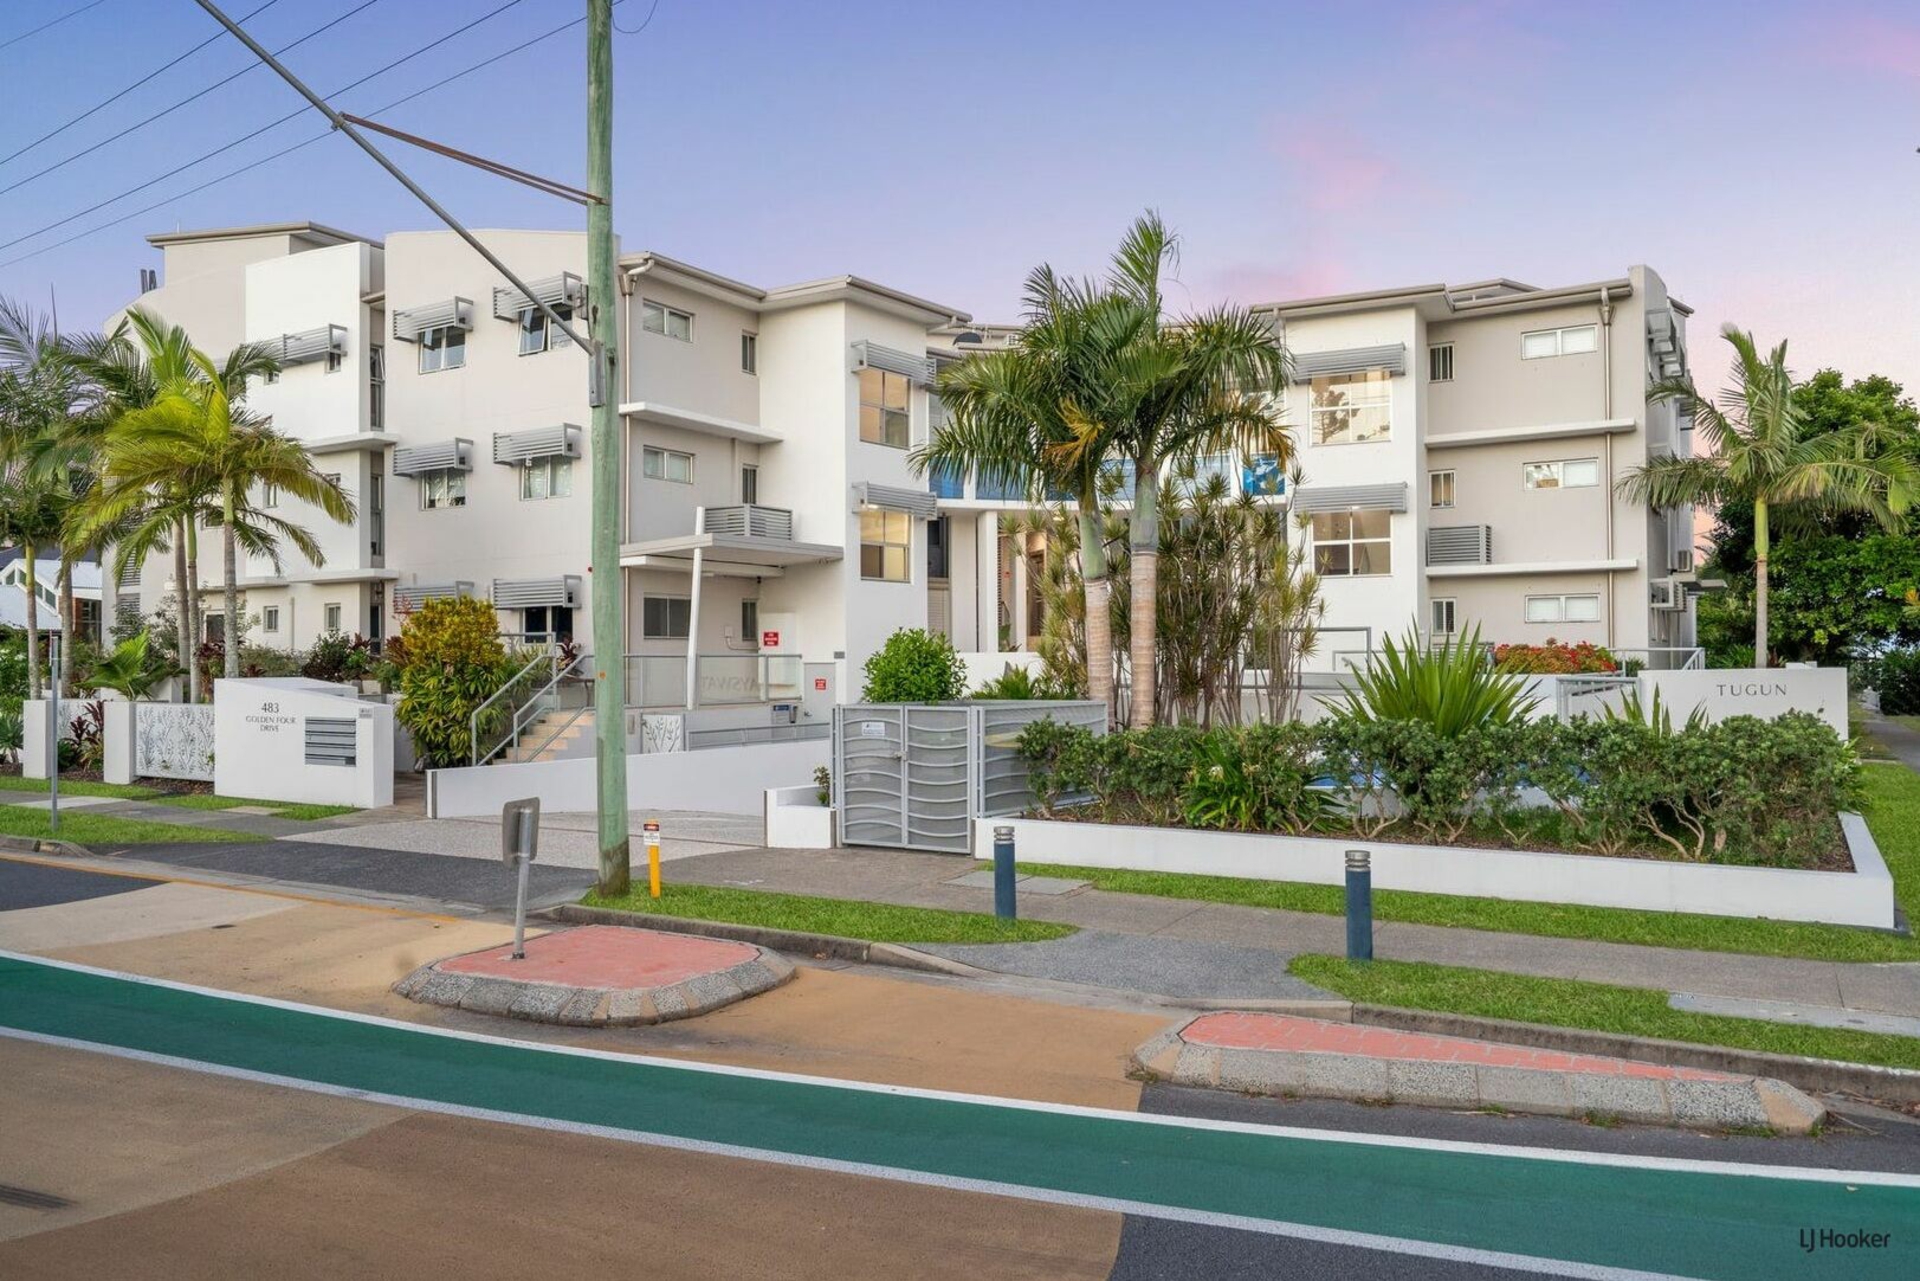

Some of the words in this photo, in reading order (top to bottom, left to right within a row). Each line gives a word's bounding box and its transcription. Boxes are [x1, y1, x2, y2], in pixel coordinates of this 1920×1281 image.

[1716, 683, 1787, 697] TUGUN
[261, 702, 279, 713] 483
[245, 715, 275, 723] GOLDEN
[260, 724, 279, 732] DRIVE
